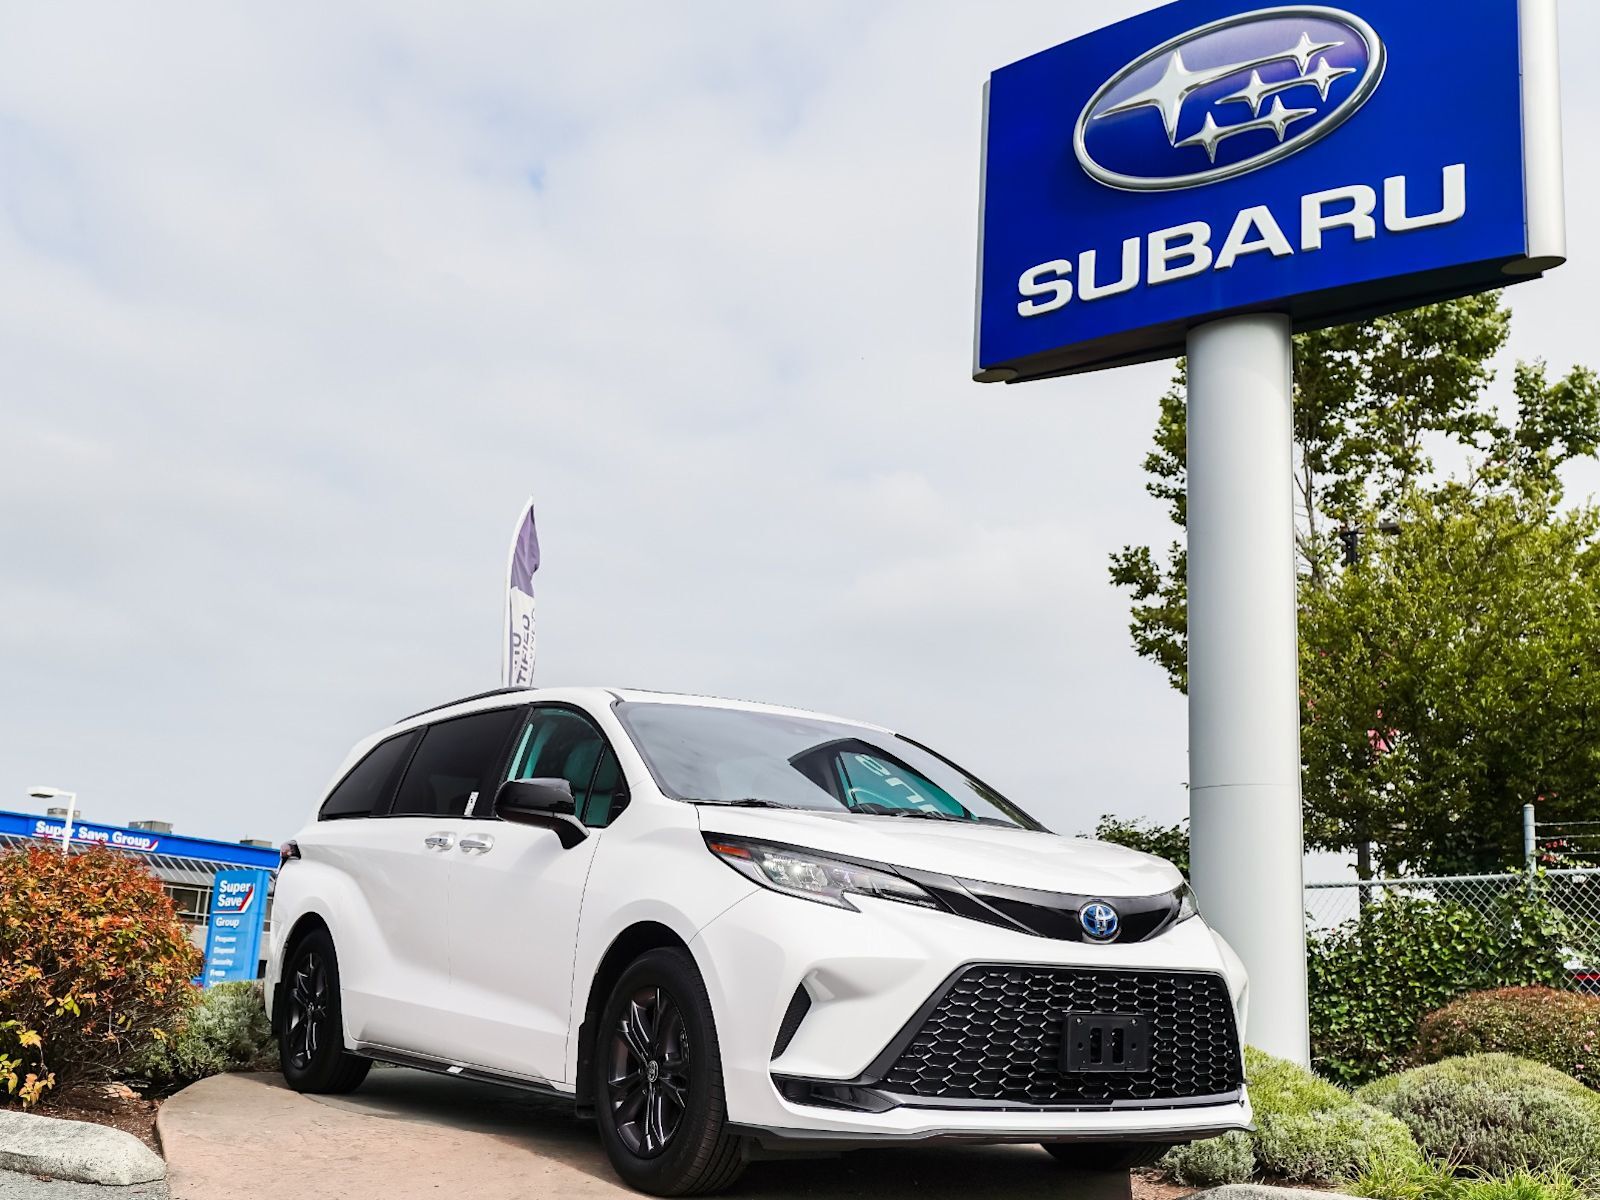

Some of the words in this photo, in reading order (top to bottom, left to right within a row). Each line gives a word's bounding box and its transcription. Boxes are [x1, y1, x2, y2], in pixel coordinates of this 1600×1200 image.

[1017, 163, 1466, 317] SUBARU
[36, 820, 75, 837] Supr
[78, 826, 108, 841] Save
[112, 831, 150, 848] Group
[219, 880, 251, 895] Super
[217, 894, 243, 907] Save
[215, 917, 240, 928] Group
